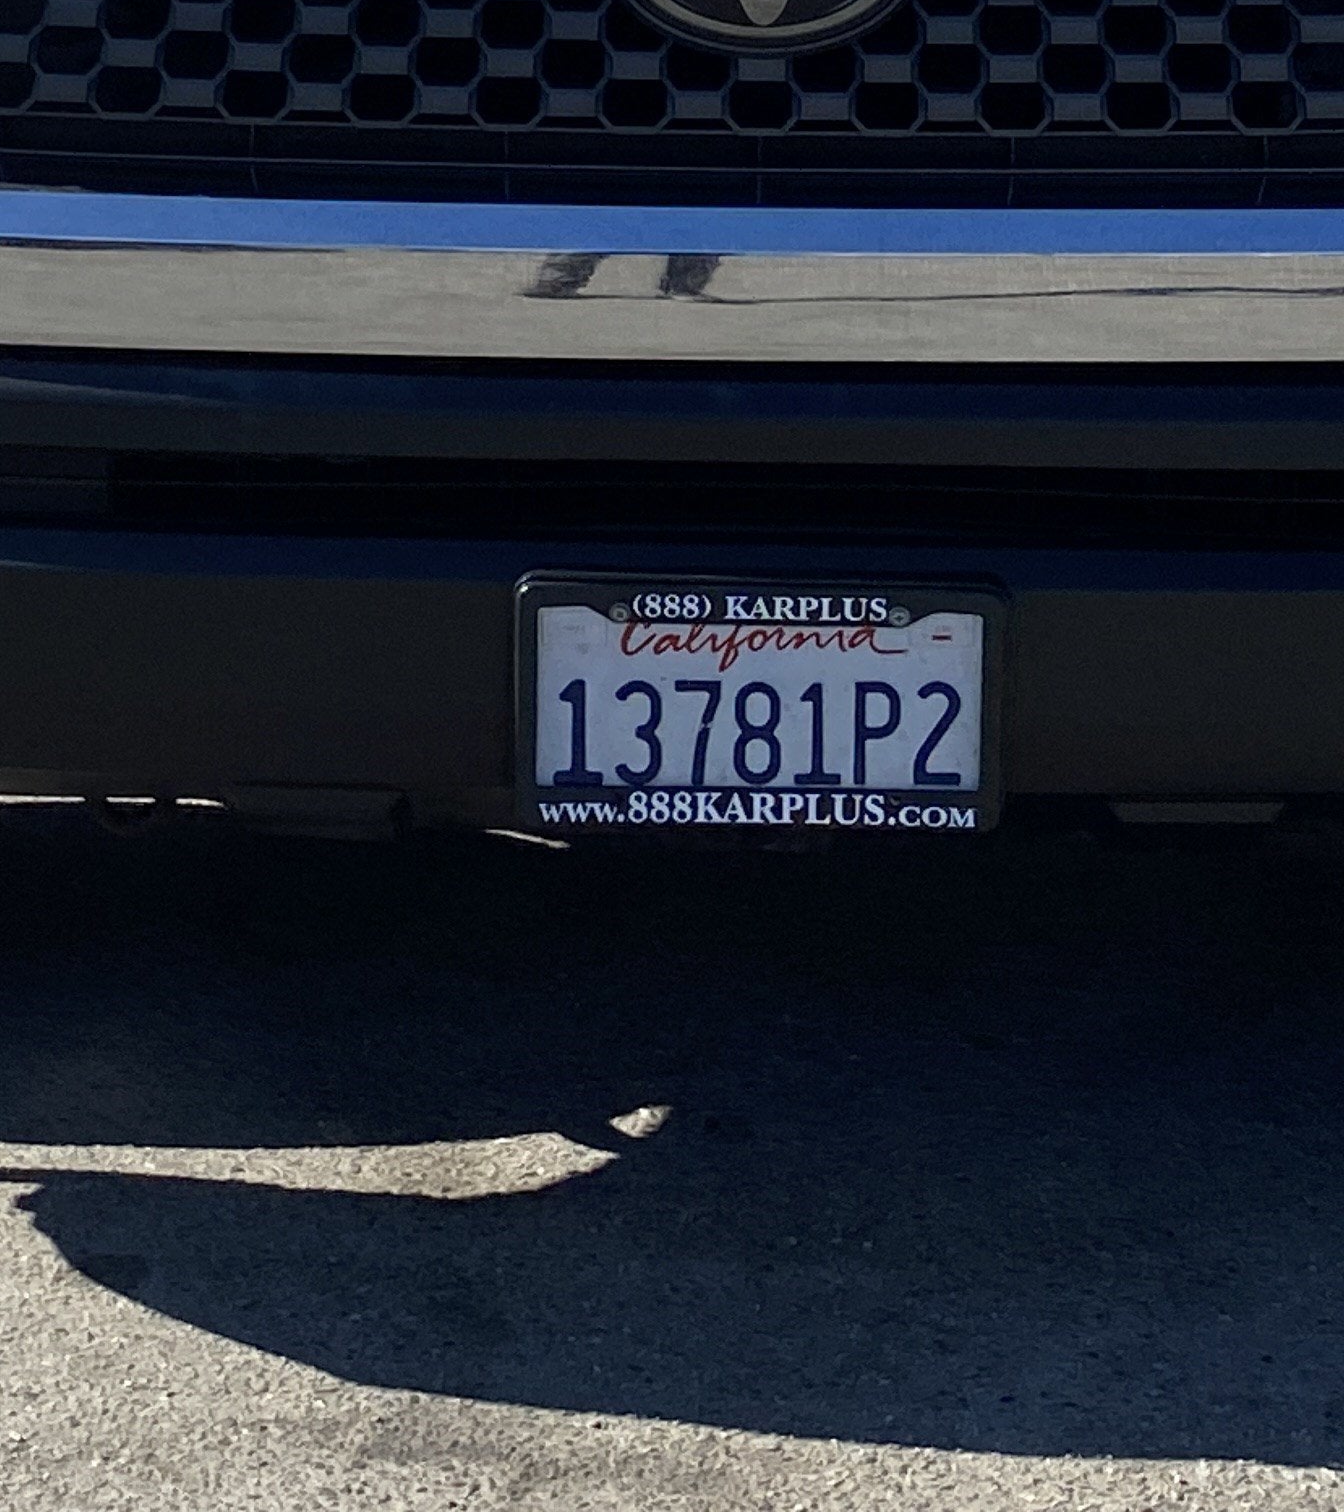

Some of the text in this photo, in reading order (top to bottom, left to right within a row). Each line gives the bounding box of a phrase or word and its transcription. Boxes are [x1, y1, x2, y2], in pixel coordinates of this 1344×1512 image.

[632, 593, 888, 622] (888) KARPLUS
[620, 620, 908, 672] California
[553, 678, 962, 787] 13781P2
